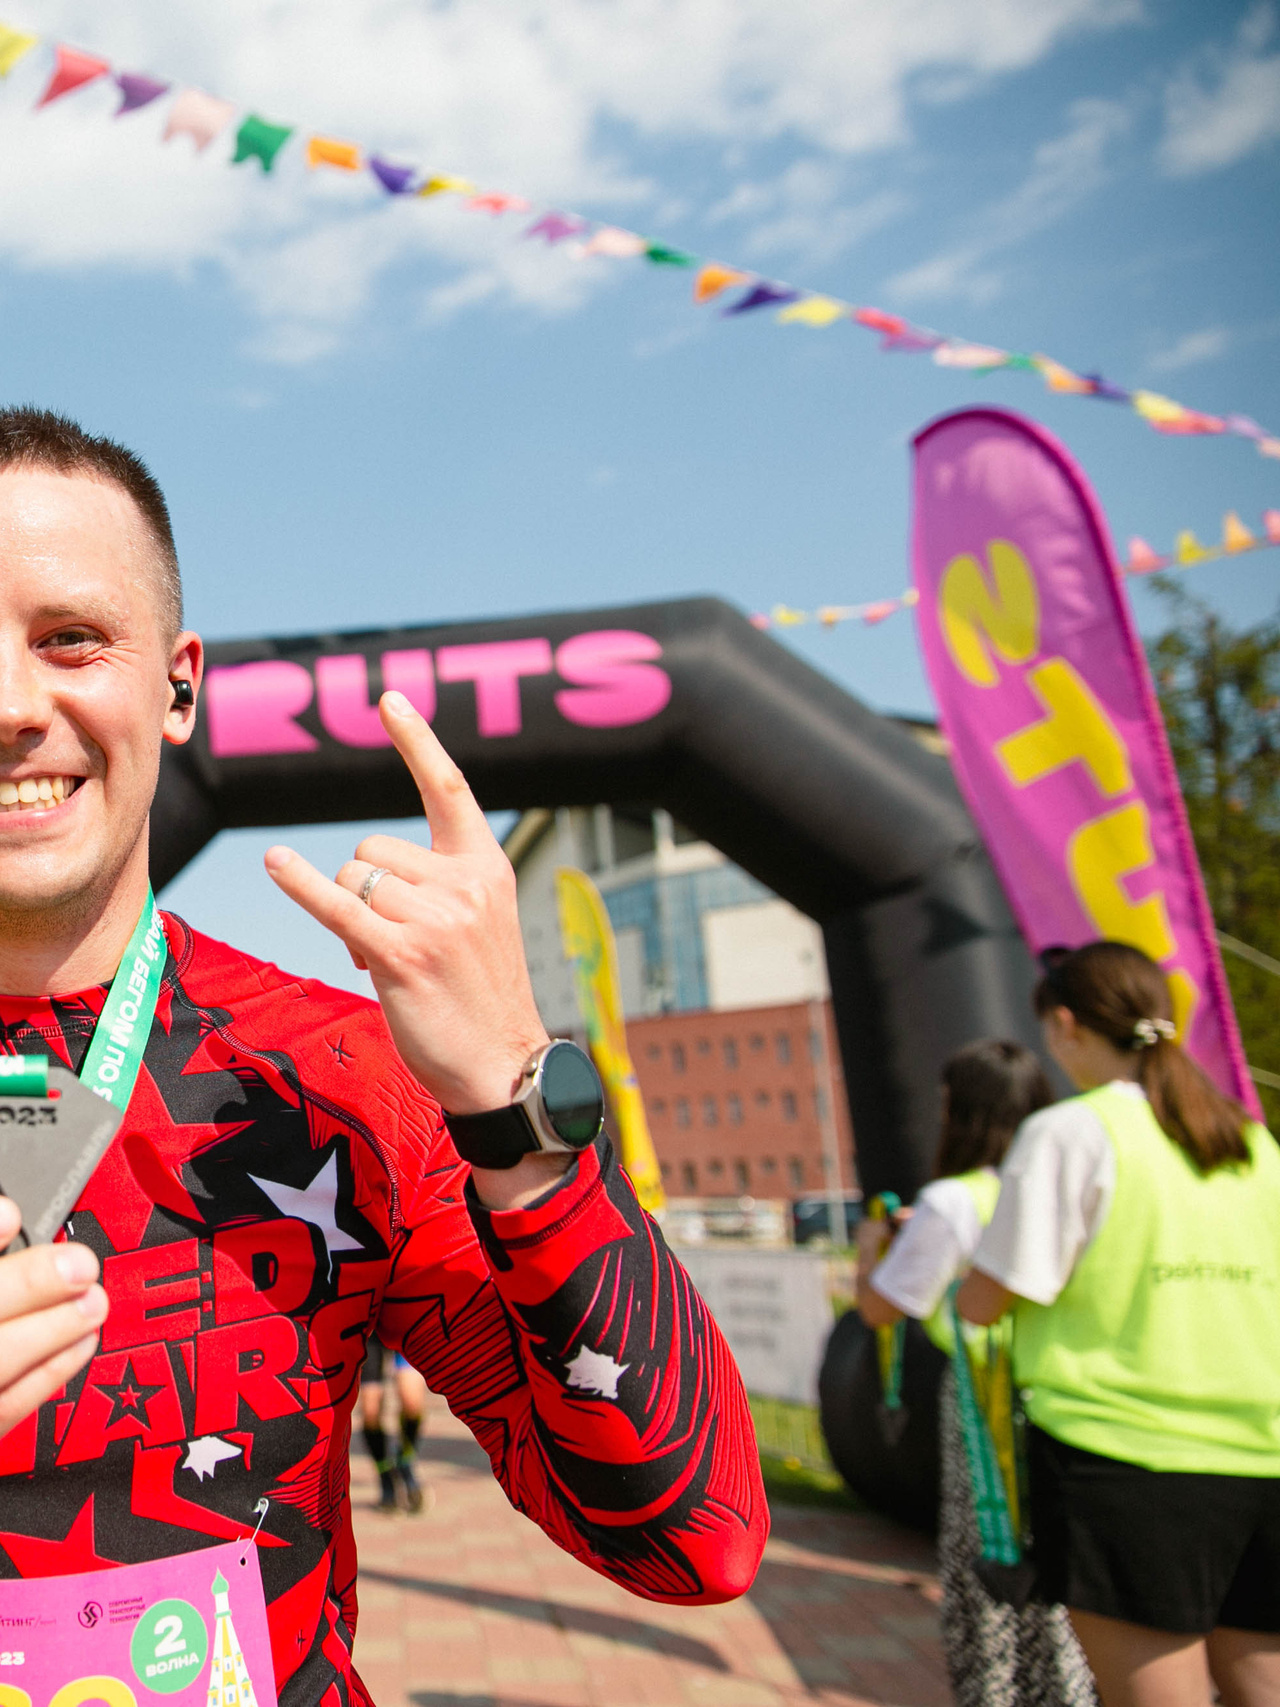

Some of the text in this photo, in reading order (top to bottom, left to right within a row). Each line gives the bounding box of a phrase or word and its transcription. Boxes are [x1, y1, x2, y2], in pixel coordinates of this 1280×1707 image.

[206, 629, 672, 758] RUTS
[109, 958, 151, 1055] БЕГОМ
[97, 1046, 129, 1084] ПО
[101, 1216, 318, 1351] ED
[145, 1652, 200, 1679] ВОЛНА
[154, 1615, 188, 1658] 2
